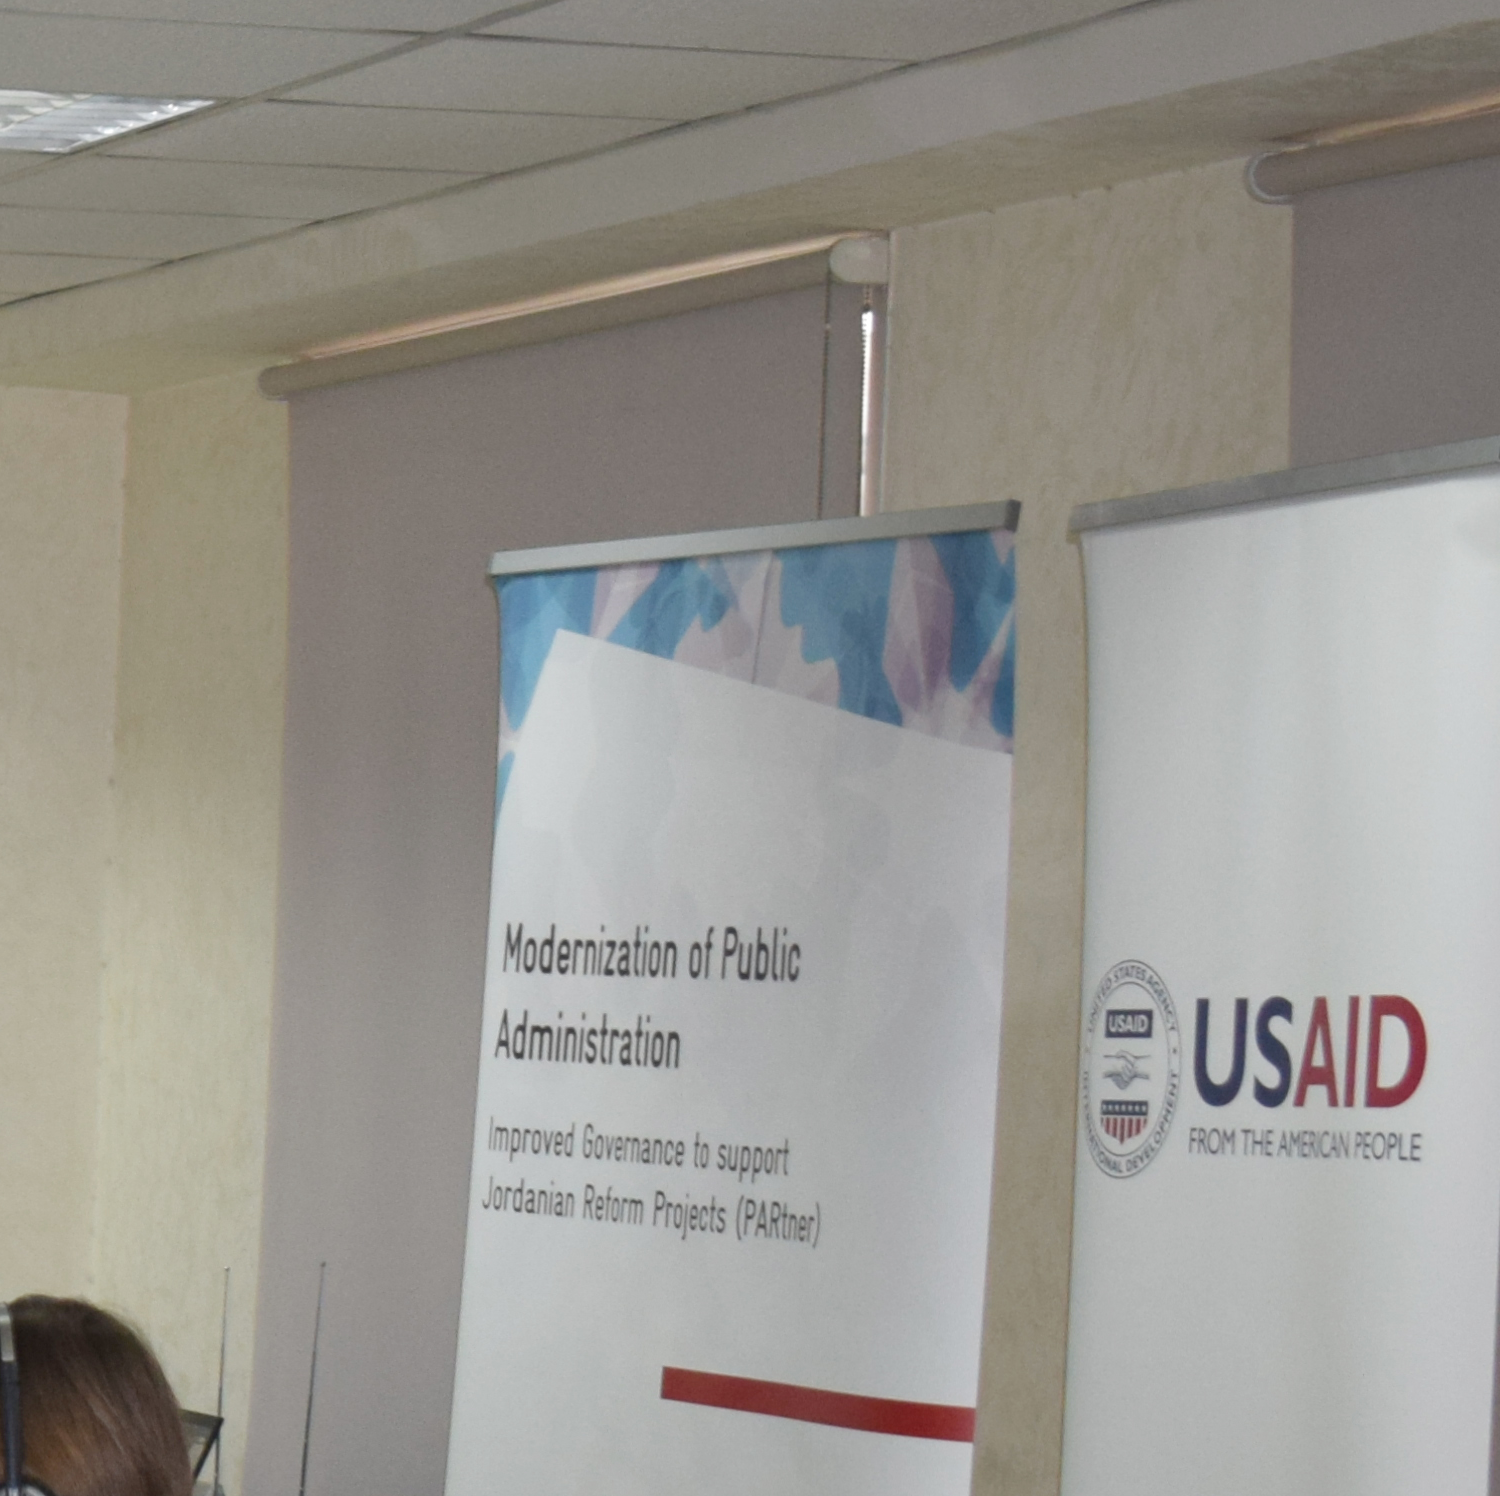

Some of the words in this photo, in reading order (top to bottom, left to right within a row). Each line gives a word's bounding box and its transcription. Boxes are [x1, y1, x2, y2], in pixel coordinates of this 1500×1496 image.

[502, 922, 678, 982] Modernization
[688, 929, 715, 981] of
[721, 926, 802, 984] Public
[1114, 965, 1146, 983] STATES
[494, 1008, 682, 1071] Administration
[1107, 1014, 1150, 1034] USAID
[1193, 994, 1428, 1108] USAID
[487, 1115, 575, 1164] Improved
[582, 1123, 685, 1169] Governance
[693, 1132, 711, 1168] to
[716, 1138, 791, 1182] support
[1189, 1128, 1236, 1156] FROM
[1241, 1128, 1275, 1157] THE
[1278, 1129, 1351, 1160] AMERICAN
[1354, 1131, 1423, 1163] PEOPLE
[481, 1176, 576, 1218] Jordanian
[583, 1185, 645, 1227] Reform
[653, 1192, 728, 1243] Projects
[735, 1196, 823, 1248] (PARtner)
